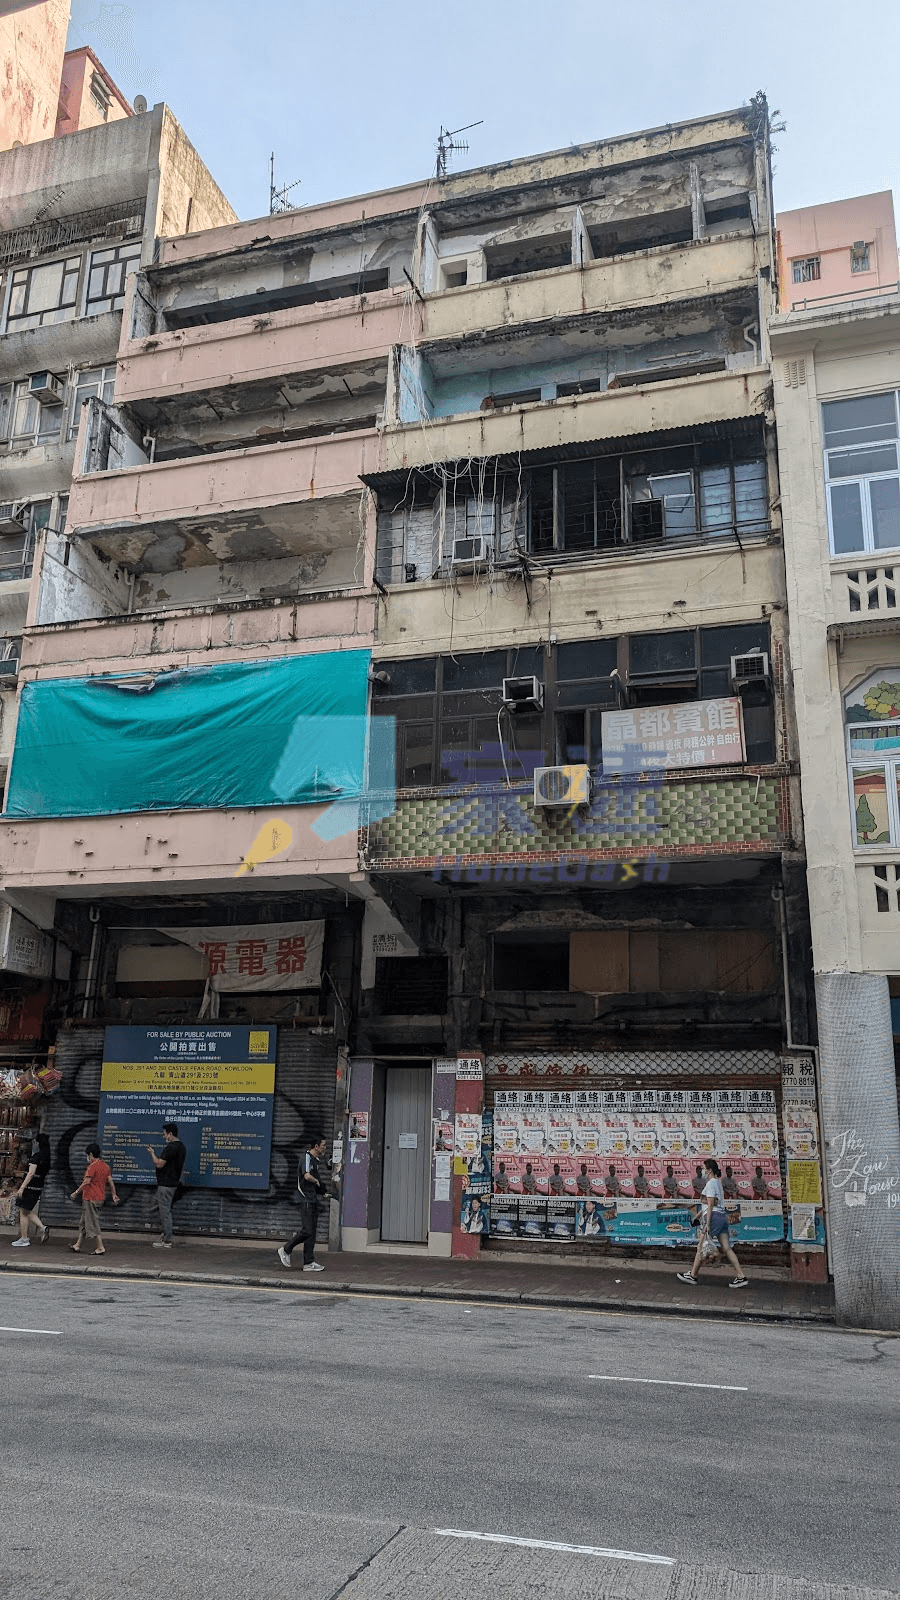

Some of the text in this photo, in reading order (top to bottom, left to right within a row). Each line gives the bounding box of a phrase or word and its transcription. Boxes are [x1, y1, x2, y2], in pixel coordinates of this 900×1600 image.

[607, 701, 738, 741] 晶都賓館
[684, 735, 714, 749] 商務公幹
[716, 732, 740, 746] 自由行
[198, 936, 307, 976] 源電器
[160, 1042, 216, 1052] 公開拍賣出售
[460, 1060, 479, 1070] 通絡
[782, 1078, 797, 1086] 2770
[497, 1092, 518, 1102] 通絡
[524, 1092, 545, 1102] 通絡
[550, 1093, 571, 1103] 通絡
[577, 1092, 599, 1102] 通絡
[604, 1092, 626, 1102] 通絡
[632, 1092, 654, 1102] 通絡
[661, 1092, 684, 1102] 通絡
[690, 1092, 712, 1102] 通絡
[718, 1092, 742, 1102] 通絡
[749, 1092, 773, 1102] 通絡
[829, 1128, 865, 1167] The
